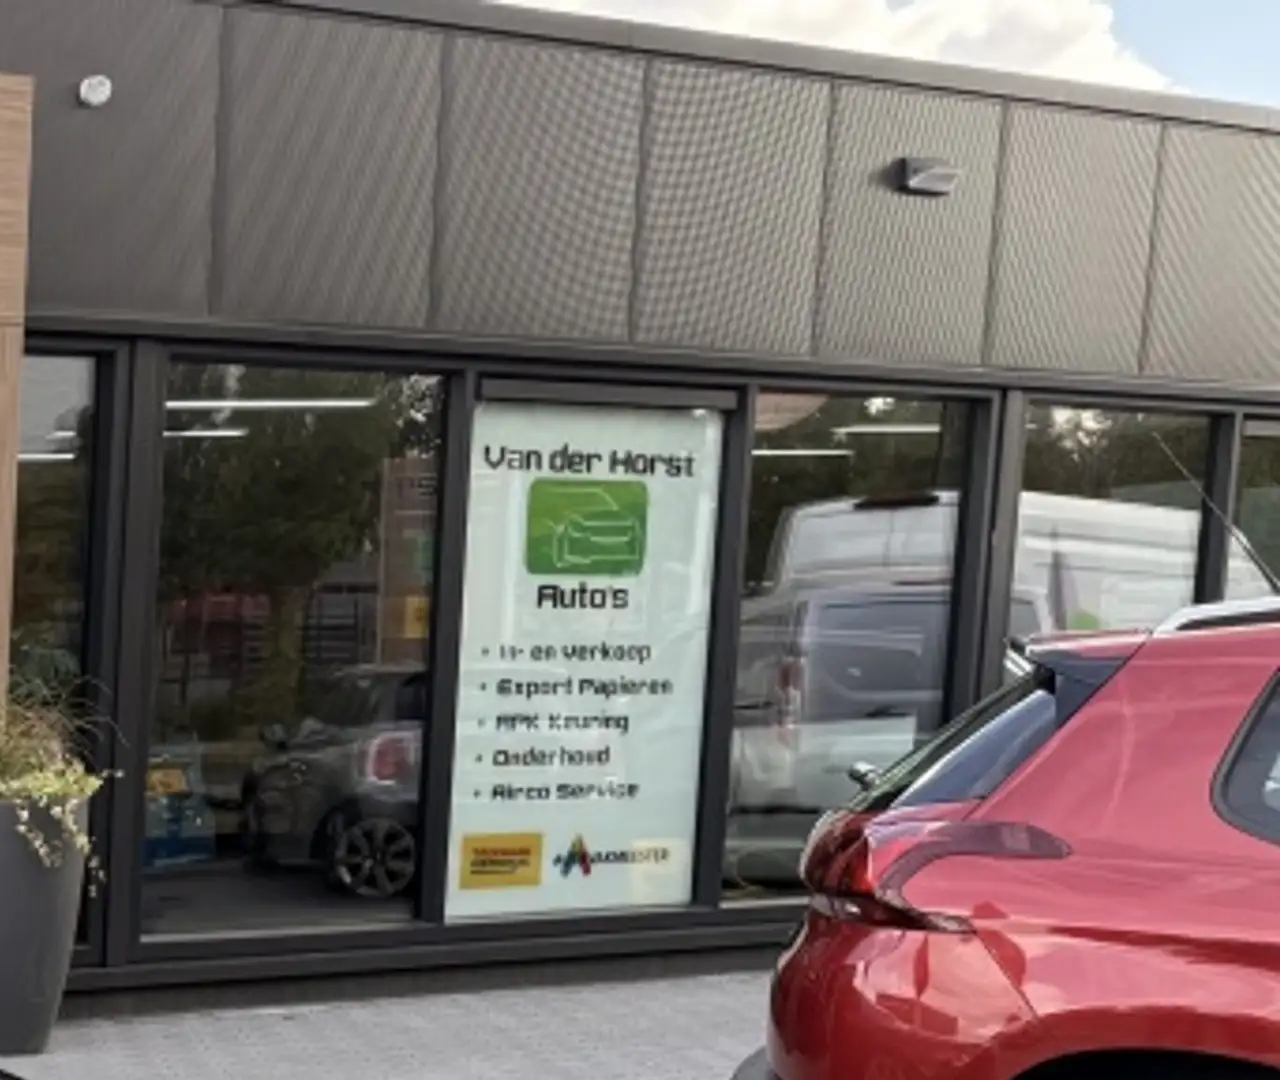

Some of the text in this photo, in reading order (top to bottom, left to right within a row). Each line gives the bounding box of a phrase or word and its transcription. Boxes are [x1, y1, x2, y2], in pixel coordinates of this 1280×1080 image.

[484, 444, 542, 474] Van
[549, 443, 602, 474] der
[536, 582, 629, 610] Auto's
